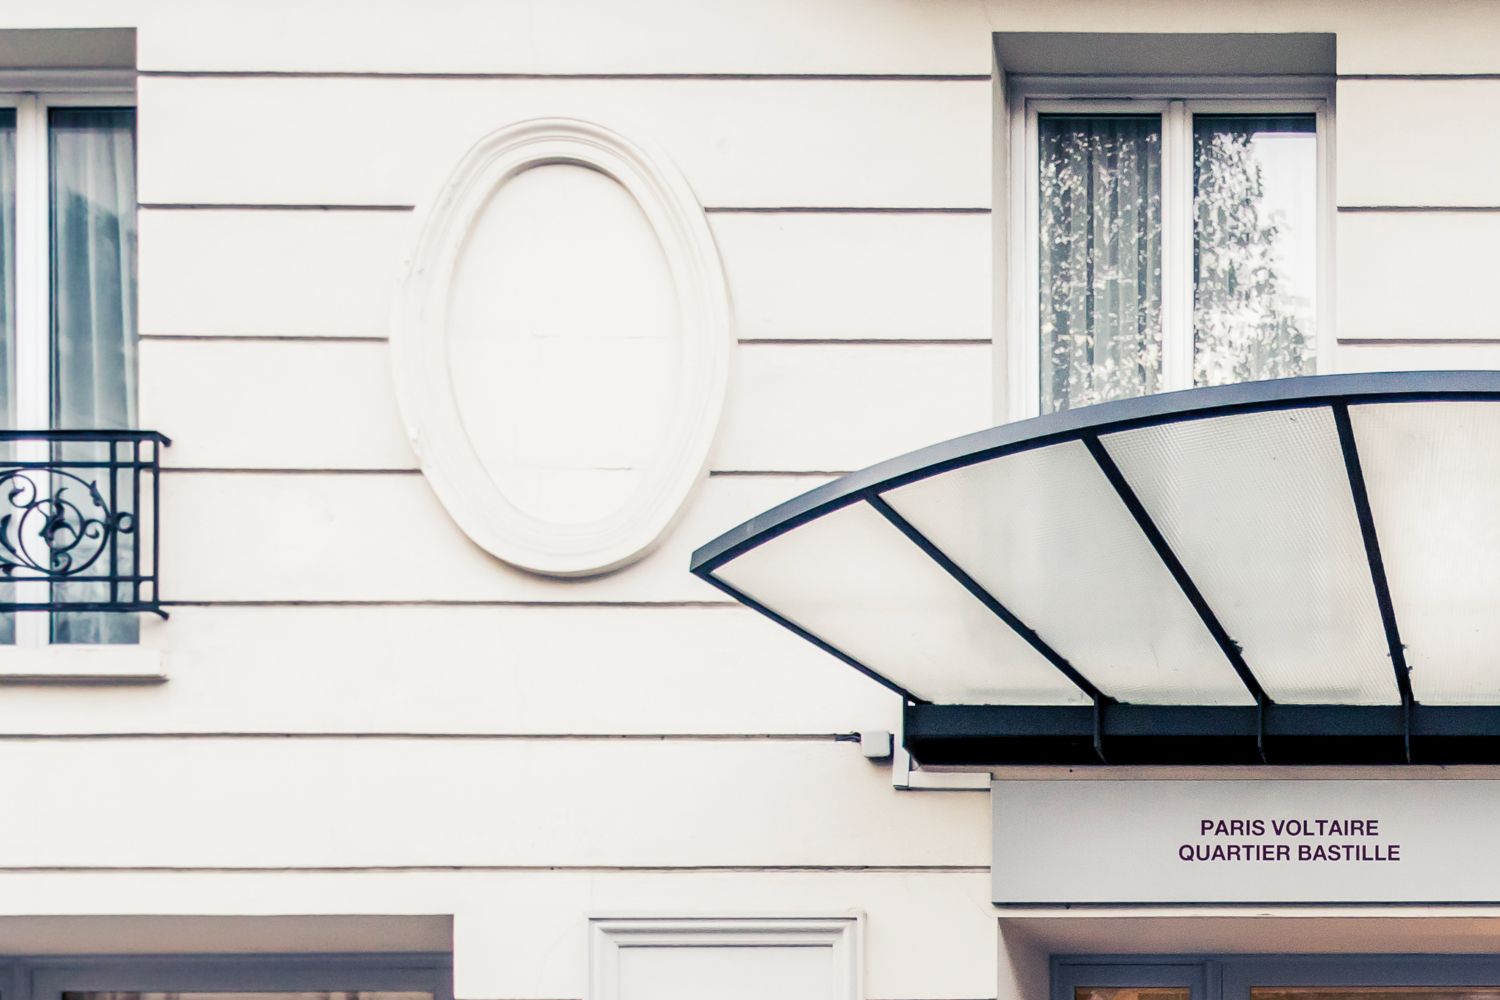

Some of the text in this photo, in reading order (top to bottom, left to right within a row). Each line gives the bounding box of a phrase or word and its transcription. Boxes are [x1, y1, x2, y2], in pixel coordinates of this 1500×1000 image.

[1200, 819, 1379, 836] PARIS VOLTAIRE
[1178, 844, 1401, 862] QUARTIER BASTILLE
